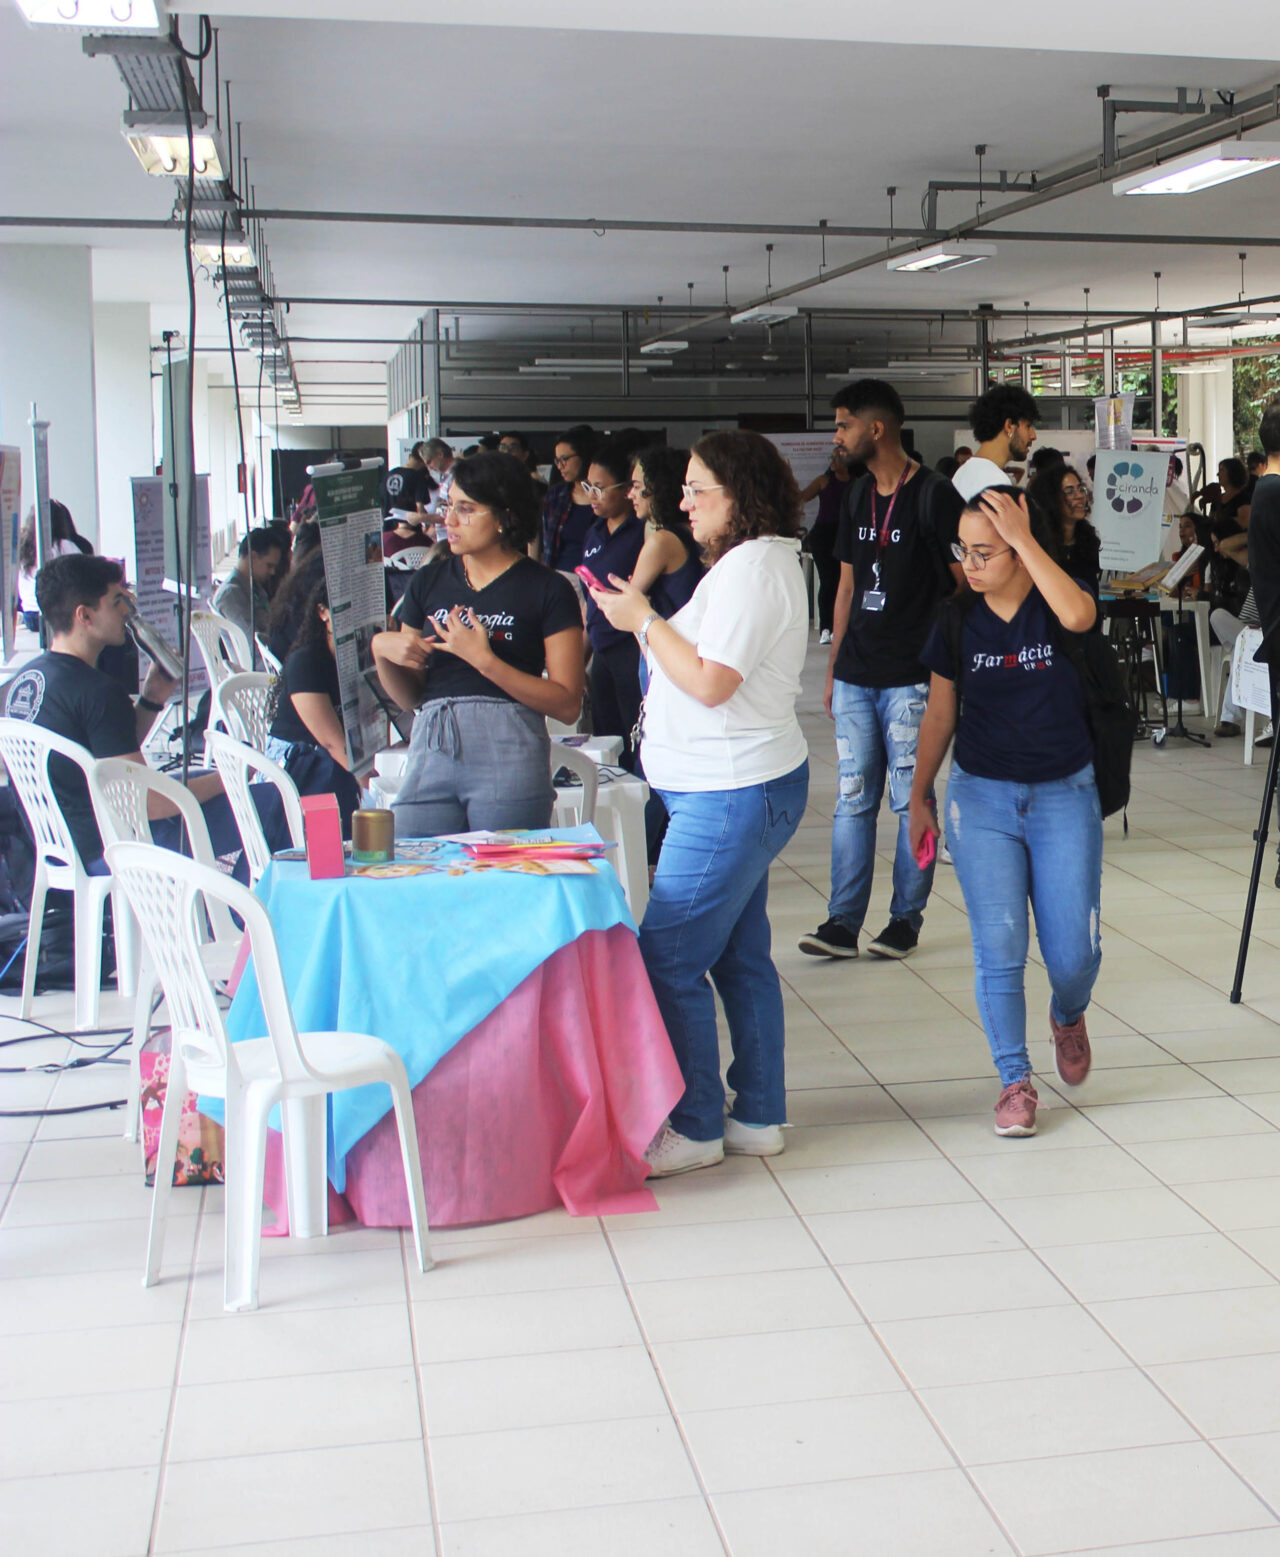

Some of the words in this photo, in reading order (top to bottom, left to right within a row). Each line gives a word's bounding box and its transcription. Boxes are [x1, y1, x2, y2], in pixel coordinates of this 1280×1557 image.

[1119, 477, 1159, 497] ciranda
[434, 608, 515, 631] Paogia
[971, 643, 1053, 672] Farmácia
